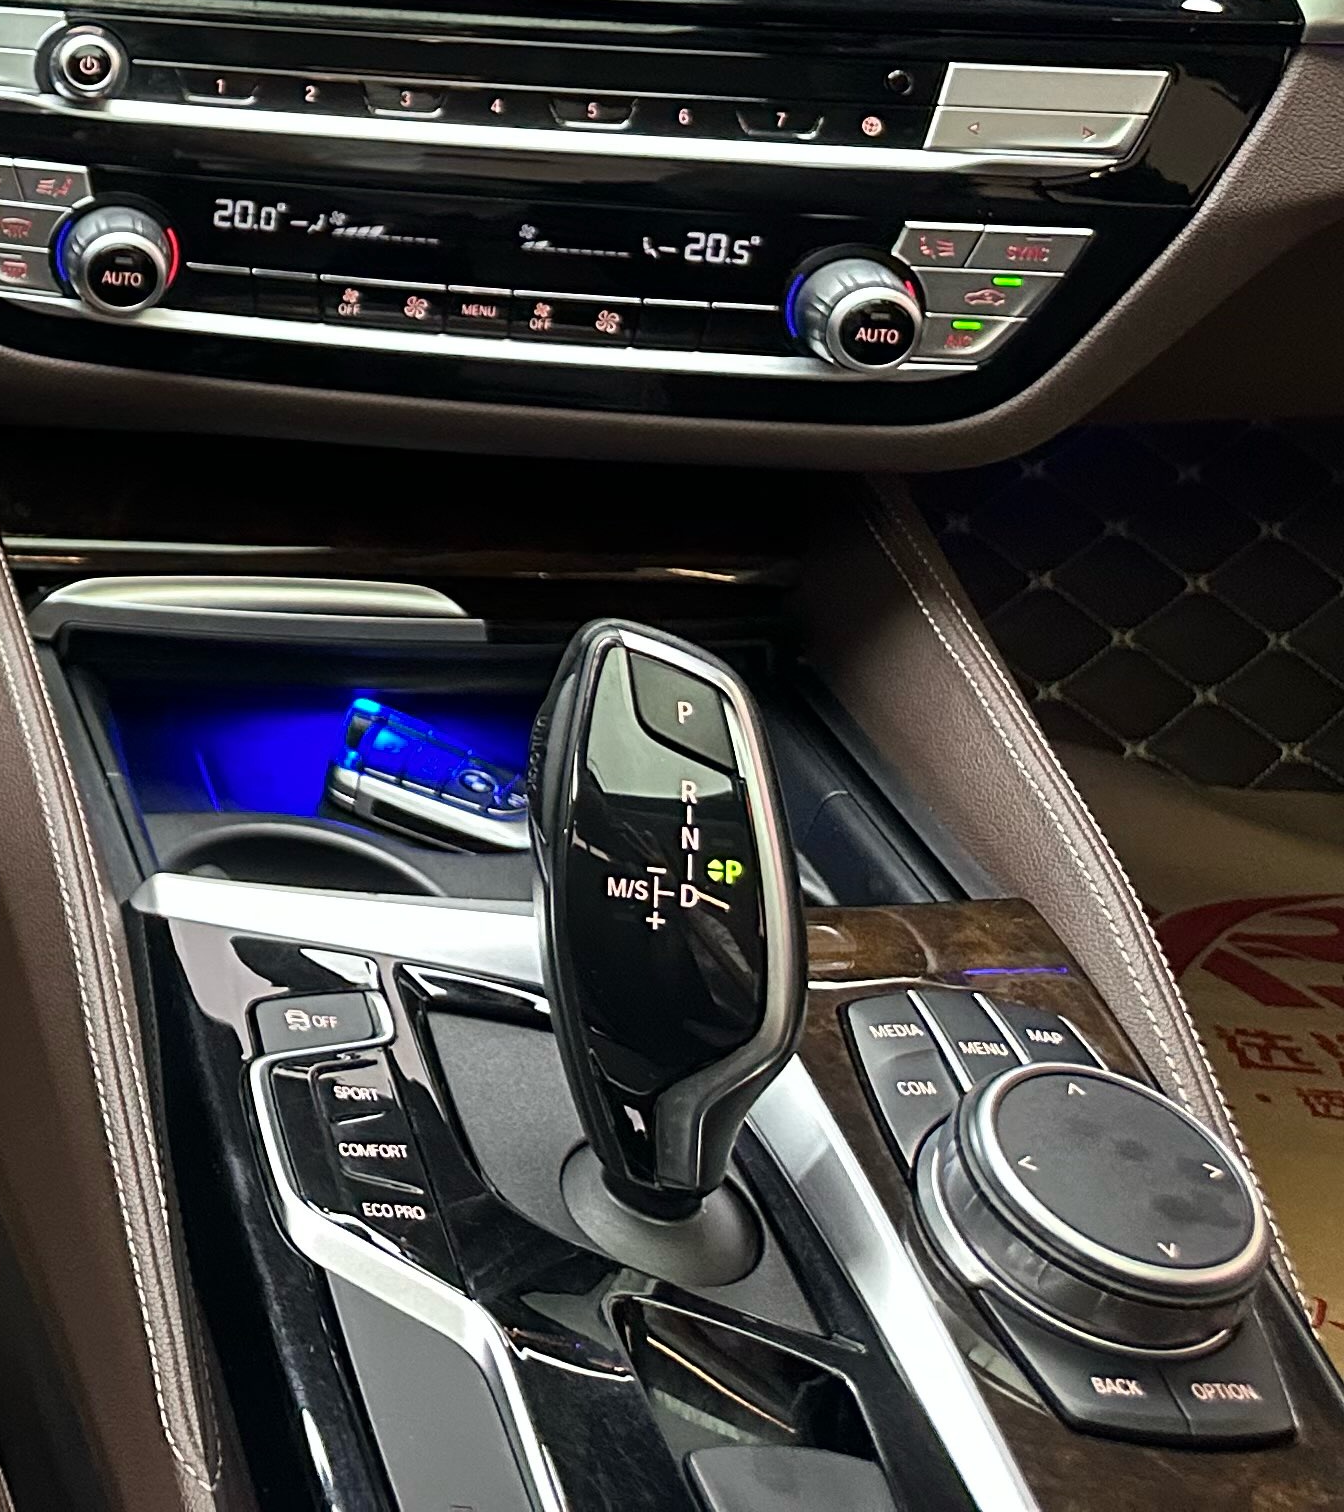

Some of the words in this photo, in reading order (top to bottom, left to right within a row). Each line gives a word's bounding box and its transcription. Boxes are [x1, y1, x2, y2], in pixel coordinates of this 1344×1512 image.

[214, 78, 226, 94] 1
[305, 85, 318, 103] 2
[399, 90, 413, 107] 3
[490, 98, 504, 115] 4
[586, 101, 600, 120] 5
[678, 107, 693, 126] 6
[776, 110, 789, 128] 7
[1005, 245, 1050, 262] SYNC
[101, 270, 142, 287] AUTO
[338, 302, 361, 317] OFF
[461, 303, 496, 318] MENU
[529, 318, 552, 331] OFF
[854, 327, 899, 345] AUTO
[676, 700, 693, 724] P
[680, 779, 698, 804] R
[680, 827, 699, 851] N
[724, 859, 743, 884] P
[606, 876, 650, 901] M/S
[679, 883, 699, 908] D
[311, 1015, 338, 1029] OFF
[868, 1023, 924, 1039] MEDIA
[1026, 1028, 1064, 1046] MAP
[957, 1040, 1009, 1057] MENU
[333, 1085, 379, 1102] SPORT
[896, 1080, 937, 1097] COM
[338, 1142, 408, 1158] COMFORT
[362, 1202, 393, 1219] ECO
[394, 1205, 426, 1221] PRO
[1090, 1376, 1145, 1397] BACK
[1190, 1382, 1264, 1401] OPTION
